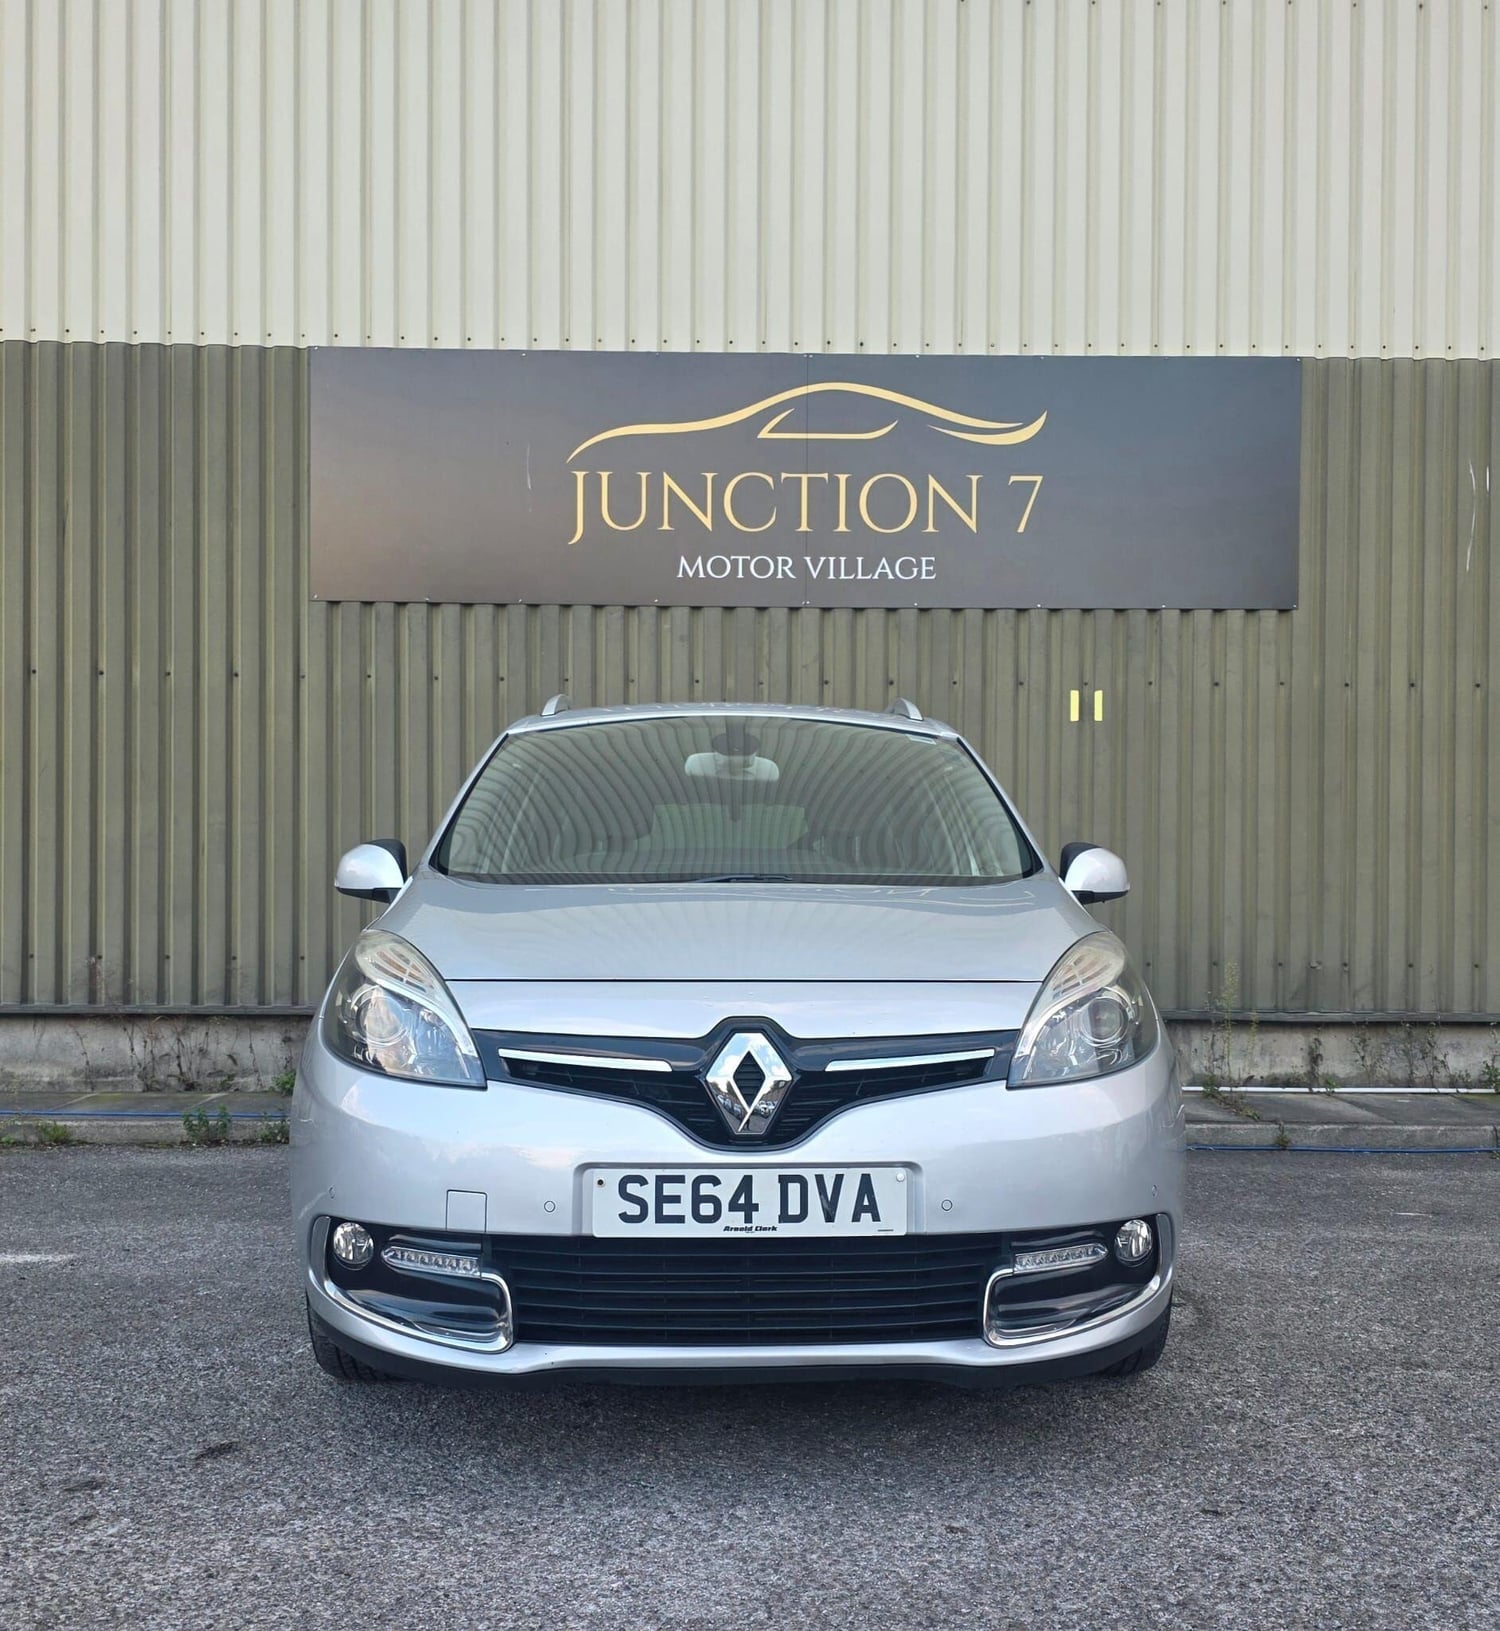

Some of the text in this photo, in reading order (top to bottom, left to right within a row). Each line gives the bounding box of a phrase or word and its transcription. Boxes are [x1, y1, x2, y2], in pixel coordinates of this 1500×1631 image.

[568, 471, 1043, 544] JUNCTION 7
[677, 555, 936, 580] MOTOR VILLAGE
[618, 1173, 881, 1224] SE64 DVA
